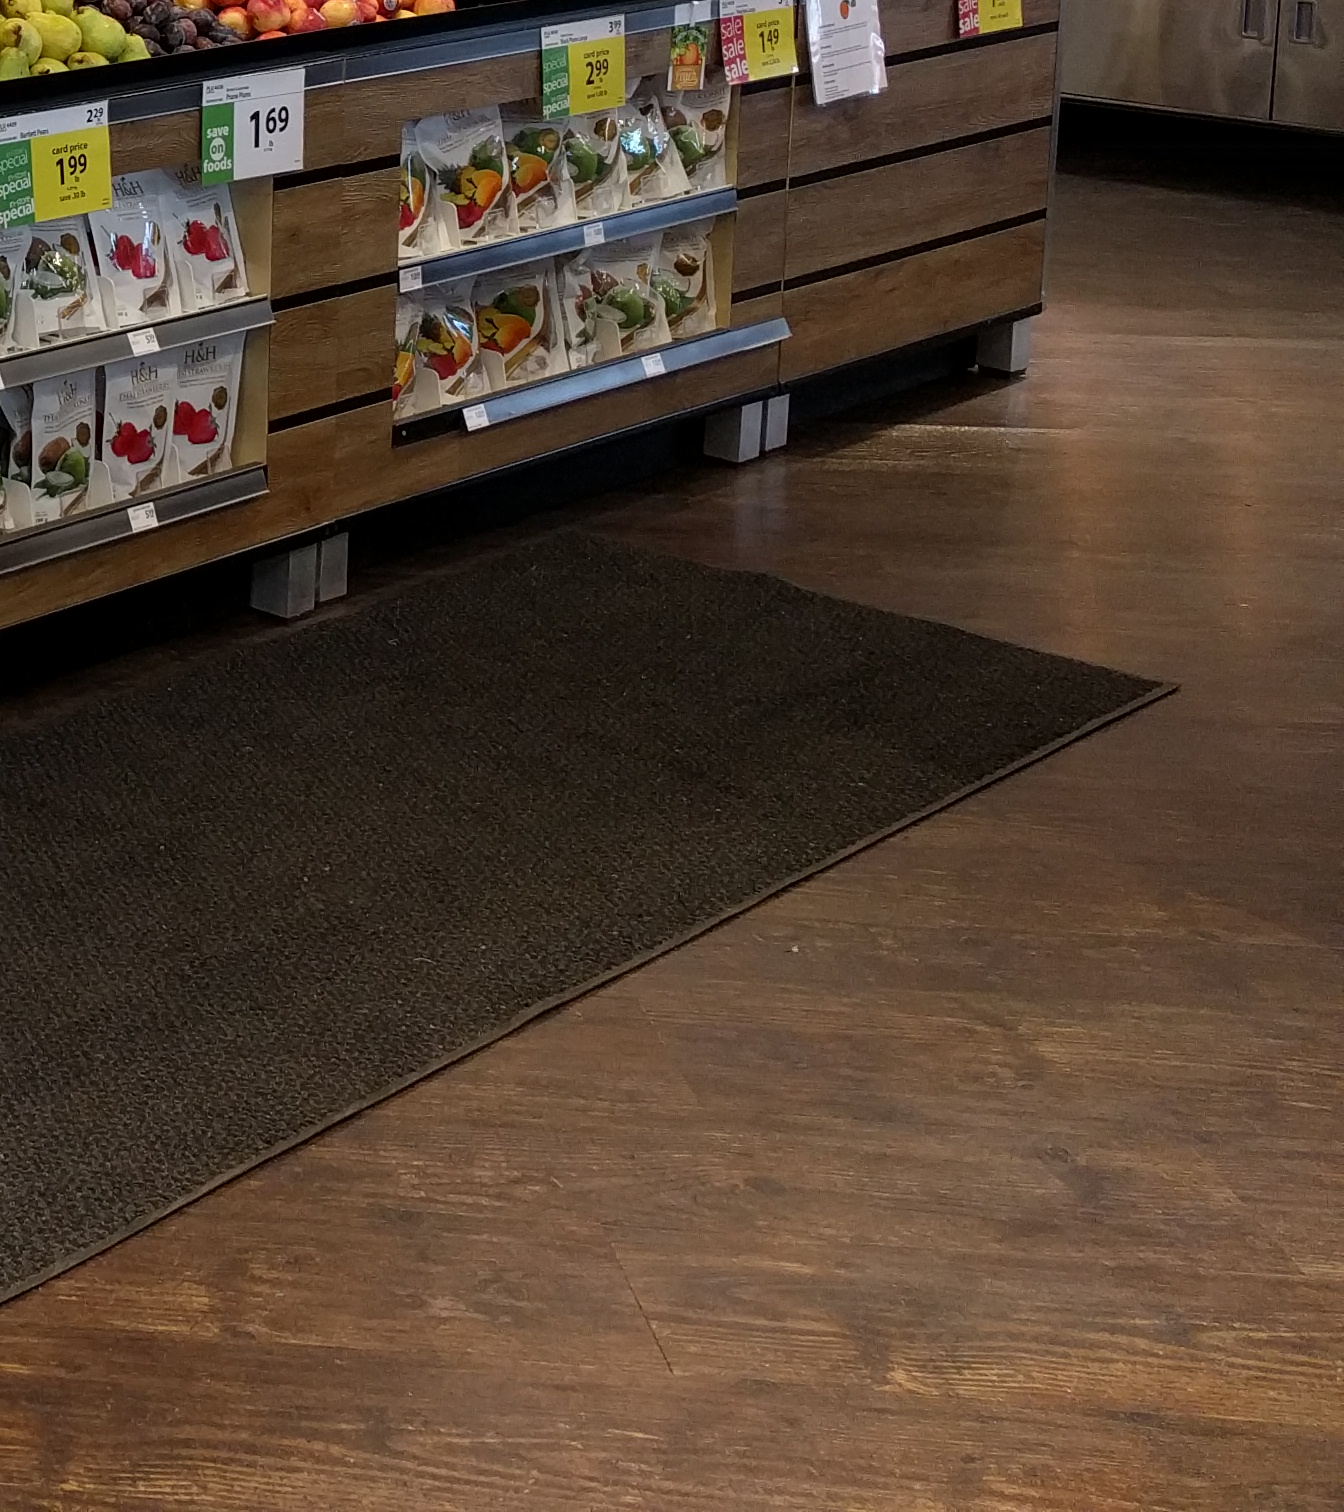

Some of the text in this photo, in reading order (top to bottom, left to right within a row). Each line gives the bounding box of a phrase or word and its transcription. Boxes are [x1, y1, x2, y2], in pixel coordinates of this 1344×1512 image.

[720, 15, 742, 40] sale
[959, 12, 979, 34] sale
[723, 37, 745, 61] sale
[725, 57, 749, 82] sale
[543, 72, 569, 94] special
[543, 95, 569, 120] special
[206, 125, 229, 139] save
[52, 142, 88, 155] card price
[211, 143, 224, 155] on
[203, 156, 232, 173] foods
